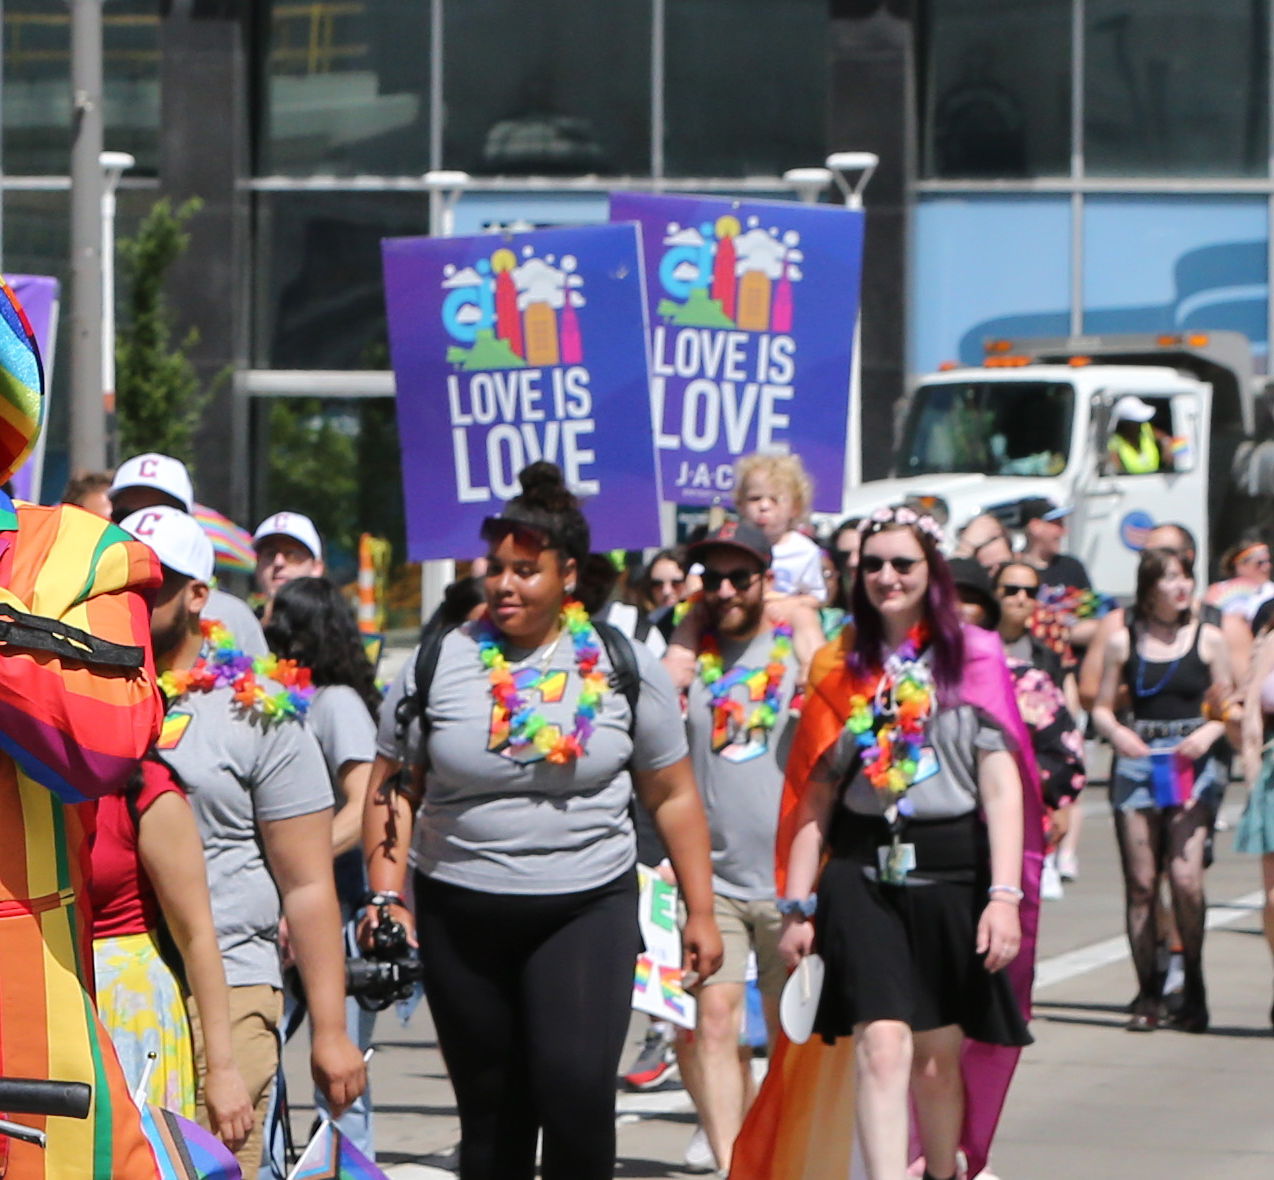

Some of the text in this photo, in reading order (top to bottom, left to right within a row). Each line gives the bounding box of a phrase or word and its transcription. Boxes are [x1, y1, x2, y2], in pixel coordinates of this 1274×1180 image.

[652, 325, 796, 385] LOVE IS
[447, 366, 592, 426] LOVE IS
[651, 376, 796, 456] LOVE
[139, 459, 158, 478] C
[452, 418, 600, 503] LOVE
[674, 461, 735, 490] JAC
[135, 512, 162, 536] C
[273, 513, 289, 531] C
